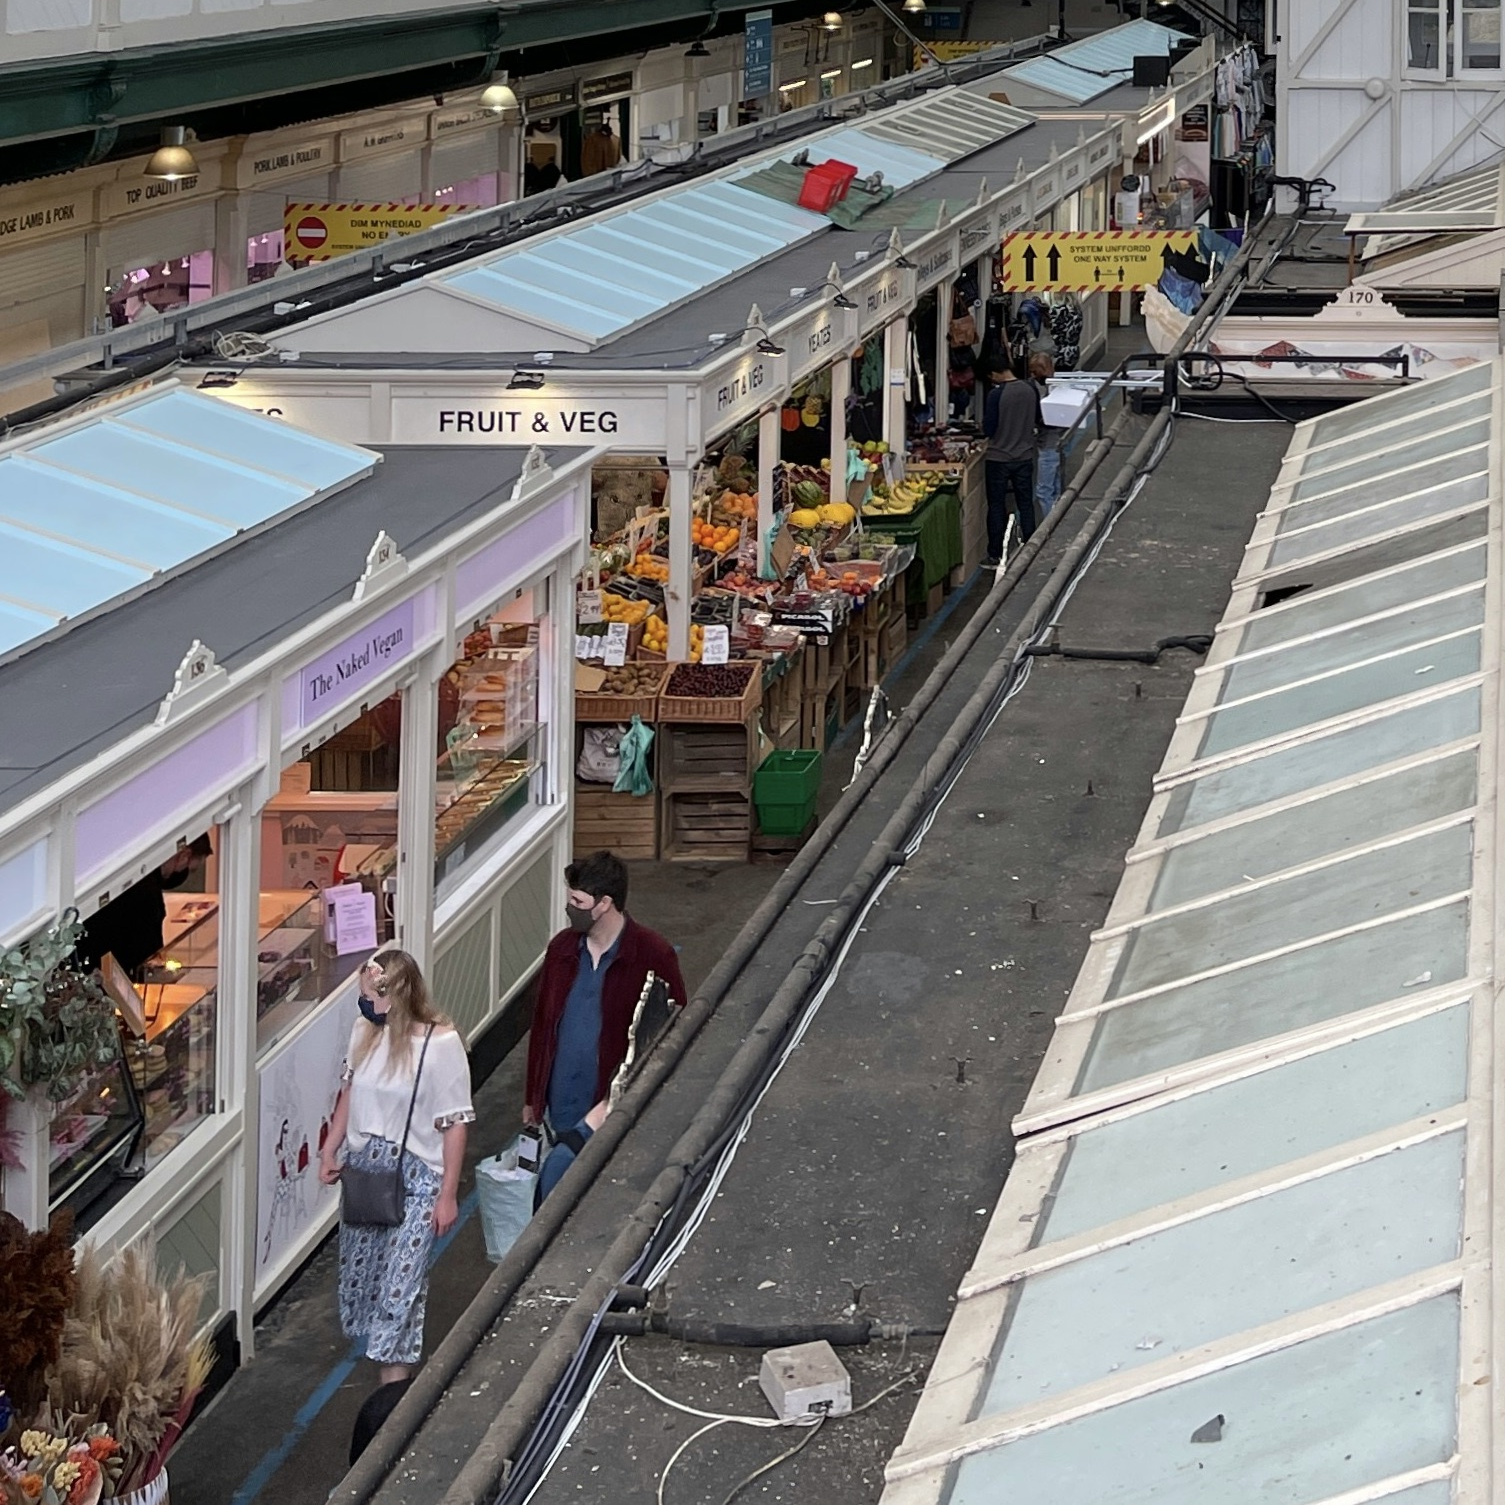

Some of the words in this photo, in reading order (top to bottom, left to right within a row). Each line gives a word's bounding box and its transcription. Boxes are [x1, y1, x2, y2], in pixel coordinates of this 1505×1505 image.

[126, 189, 142, 206] TOP
[181, 175, 198, 191] BEEF
[20, 210, 44, 232] LAMB
[46, 209, 51, 224] &
[53, 203, 75, 223] PORK
[350, 220, 368, 228] DIM
[371, 220, 422, 228] MYNEDIAD
[362, 231, 376, 239] NO
[1070, 245, 1103, 253] SYSTEM
[1105, 245, 1151, 253] UNFFORDD
[1074, 255, 1091, 263] ONE
[1093, 255, 1110, 263] WAY
[1113, 255, 1147, 263] SYSTEM
[1348, 291, 1373, 304] 170
[717, 378, 739, 411] FRUIT
[741, 375, 747, 395] &
[749, 364, 763, 390] VEG
[439, 411, 521, 432] FRUIT
[532, 412, 549, 432] &
[560, 411, 618, 432] VEG
[310, 677, 333, 702] The
[336, 644, 370, 686] Naked
[372, 626, 403, 661] Vegan
